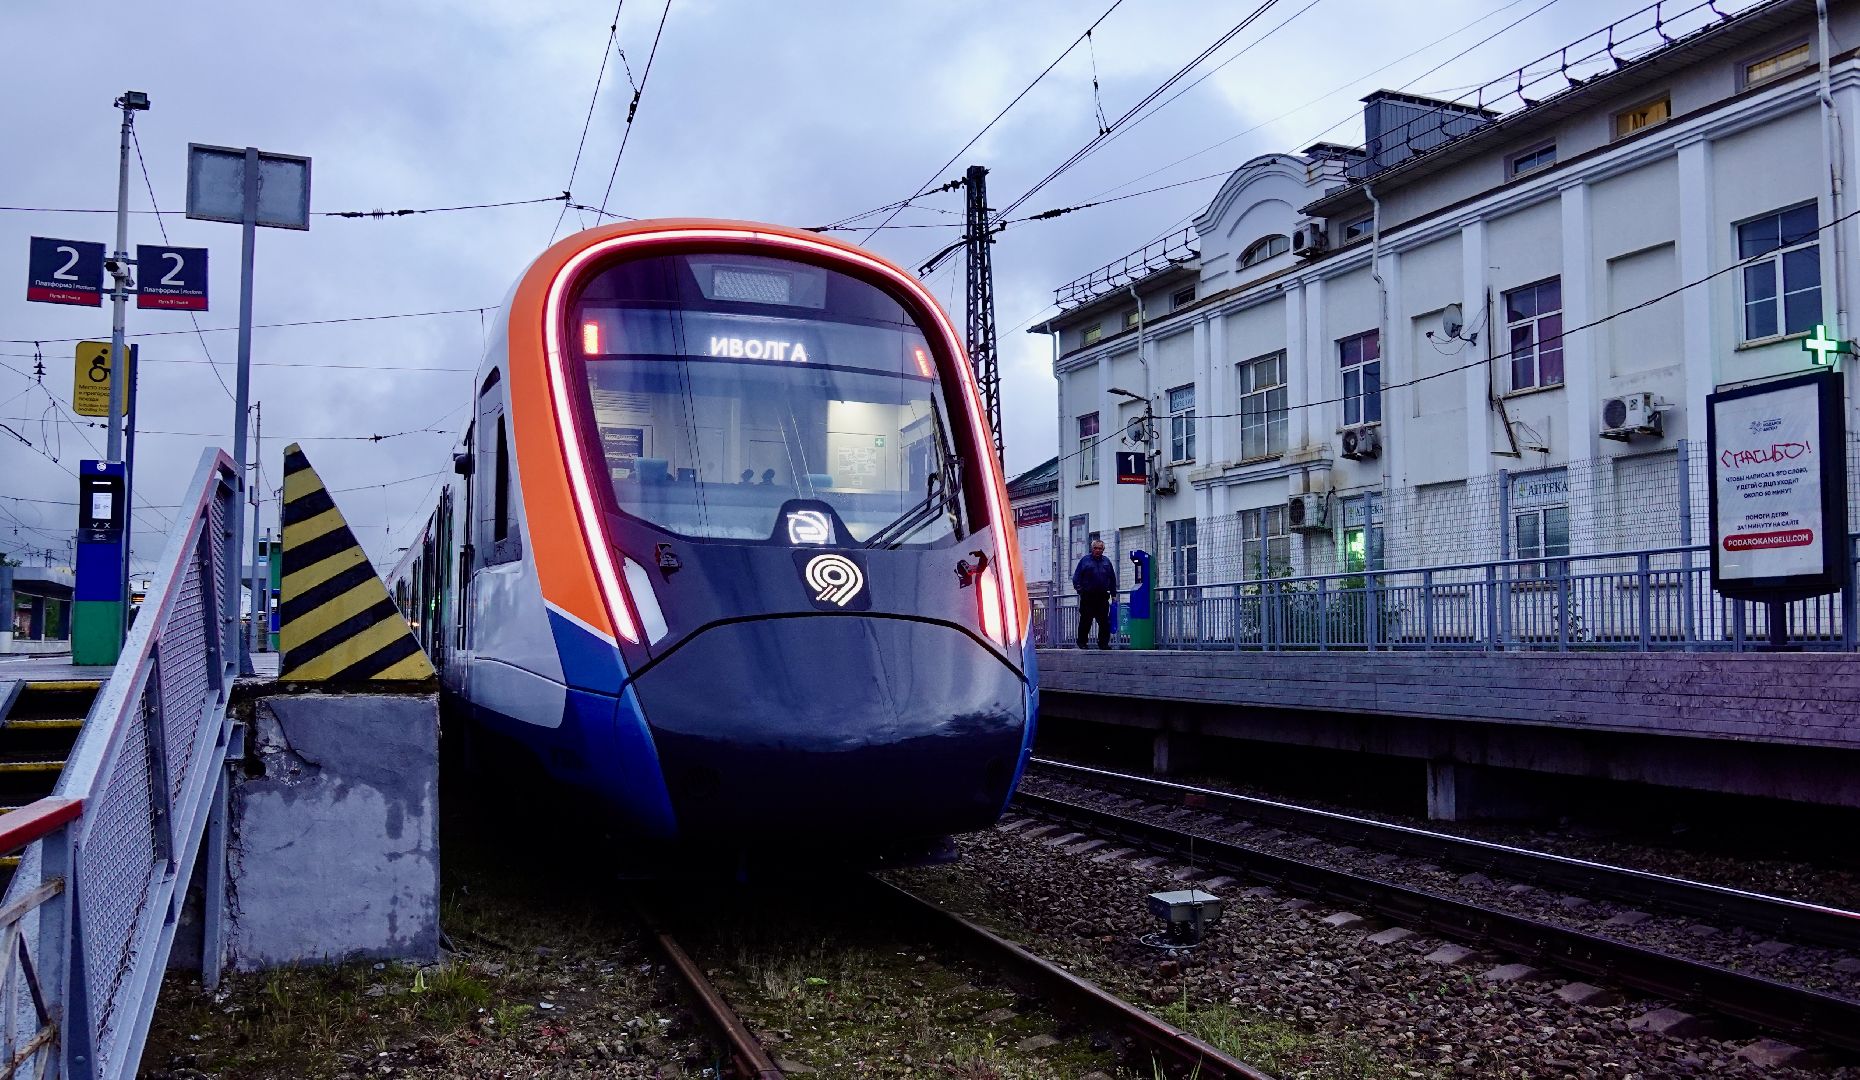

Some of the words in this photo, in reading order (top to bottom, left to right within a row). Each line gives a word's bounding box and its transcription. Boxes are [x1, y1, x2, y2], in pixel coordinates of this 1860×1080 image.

[54, 246, 79, 280] 2
[161, 253, 184, 285] 2
[35, 280, 73, 289] Платформа
[711, 336, 807, 362] ИВОЛГА
[1721, 440, 1811, 468] СПАСИБО!
[1127, 454, 1136, 474] 1
[1725, 475, 1745, 483] ЧТОБЫ
[1745, 471, 1775, 481] НАПИСАТЬ
[1528, 480, 1569, 496] АПТЕКА
[1743, 491, 1764, 499] ОКОЛО
[1772, 487, 1792, 496] МИНУТ
[1745, 512, 1770, 520] ПОМОГИ
[1747, 521, 1772, 530] МИНУТУ
[1728, 533, 1809, 547] PODAROKANGELU.COM
